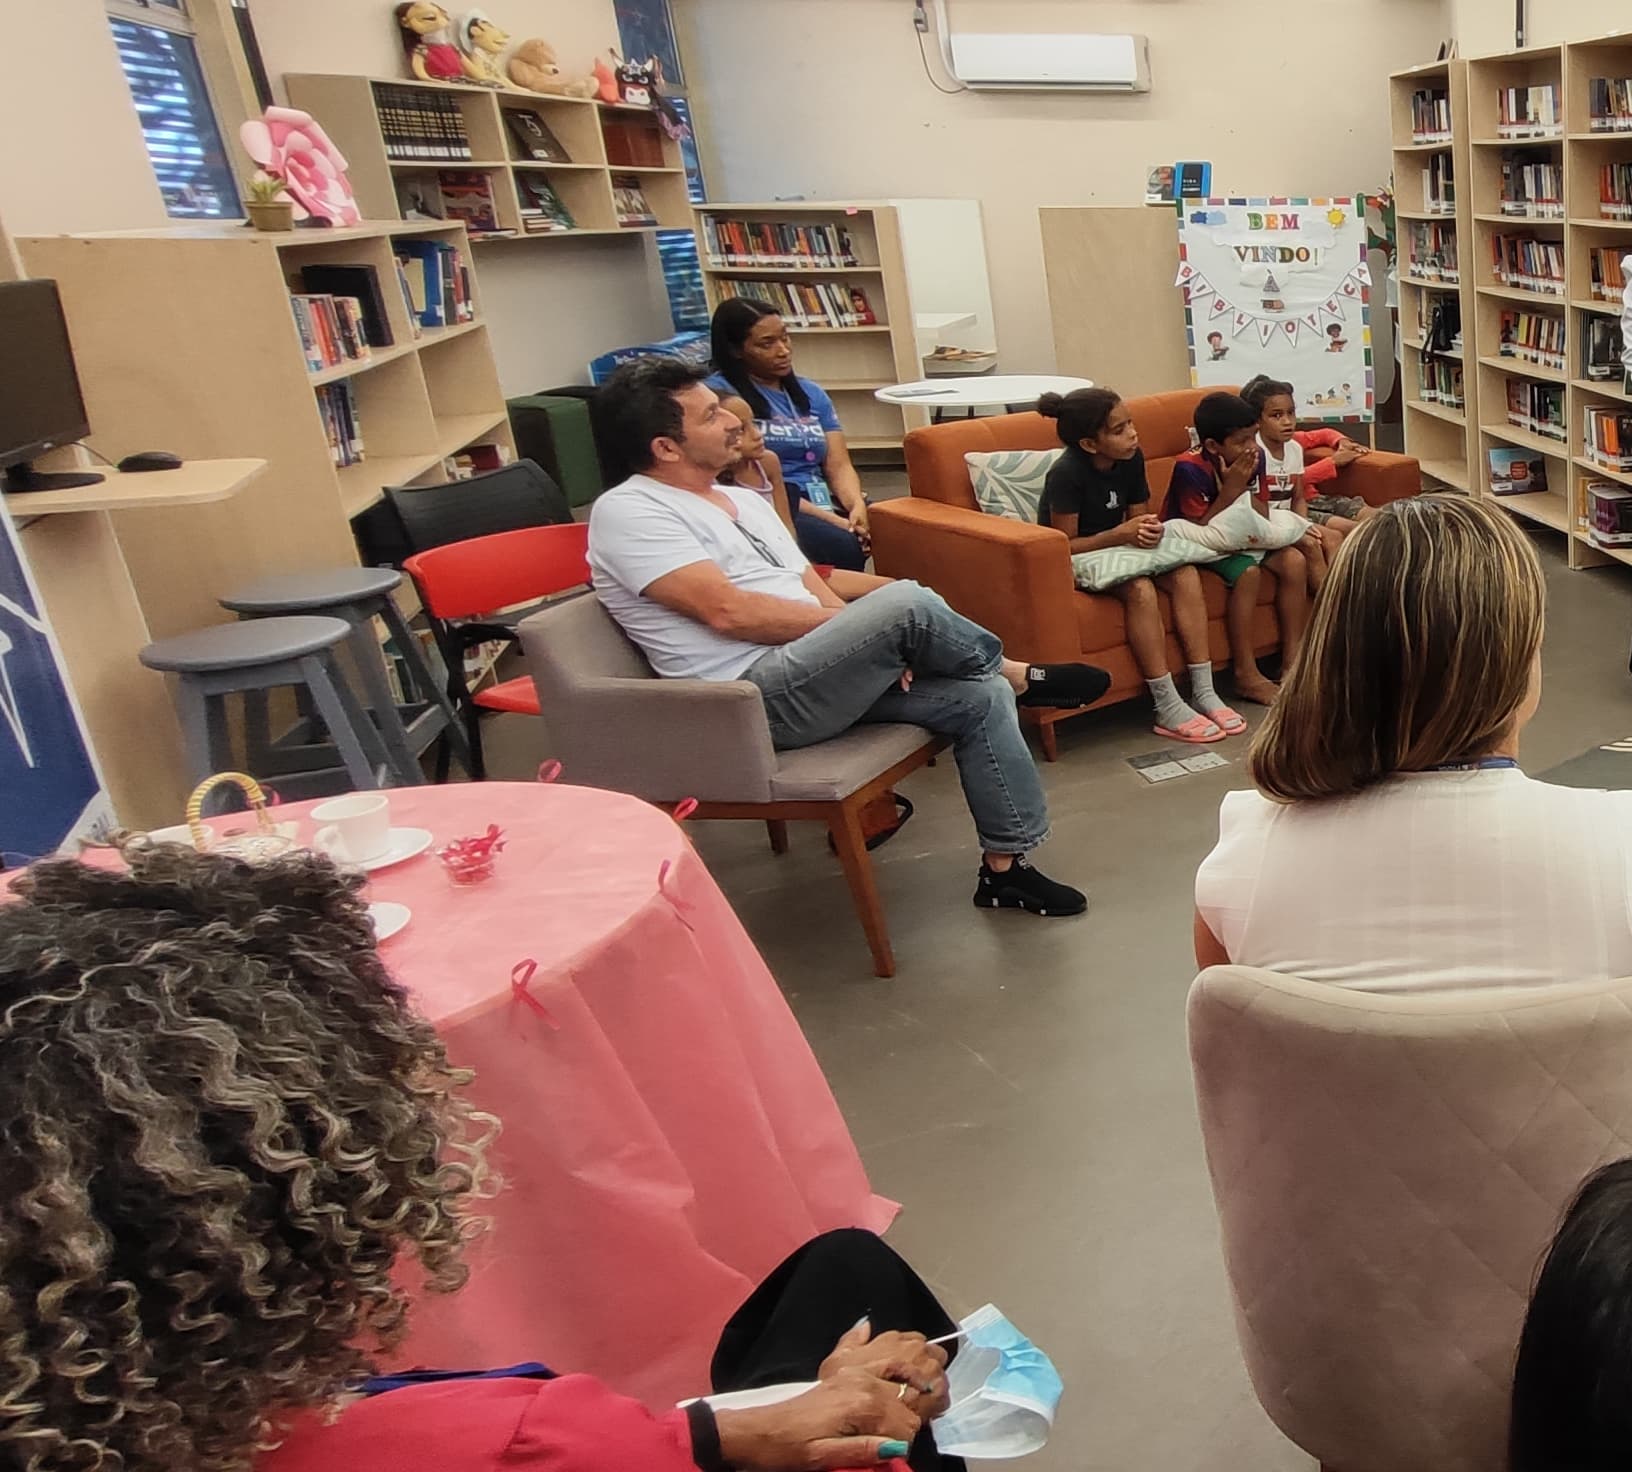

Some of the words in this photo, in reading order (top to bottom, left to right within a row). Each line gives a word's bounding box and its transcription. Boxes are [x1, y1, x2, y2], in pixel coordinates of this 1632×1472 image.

[1247, 213, 1299, 230] BEM
[1234, 246, 1319, 266] VINDO!
[1181, 267, 1367, 336] BIBLIOTECA
